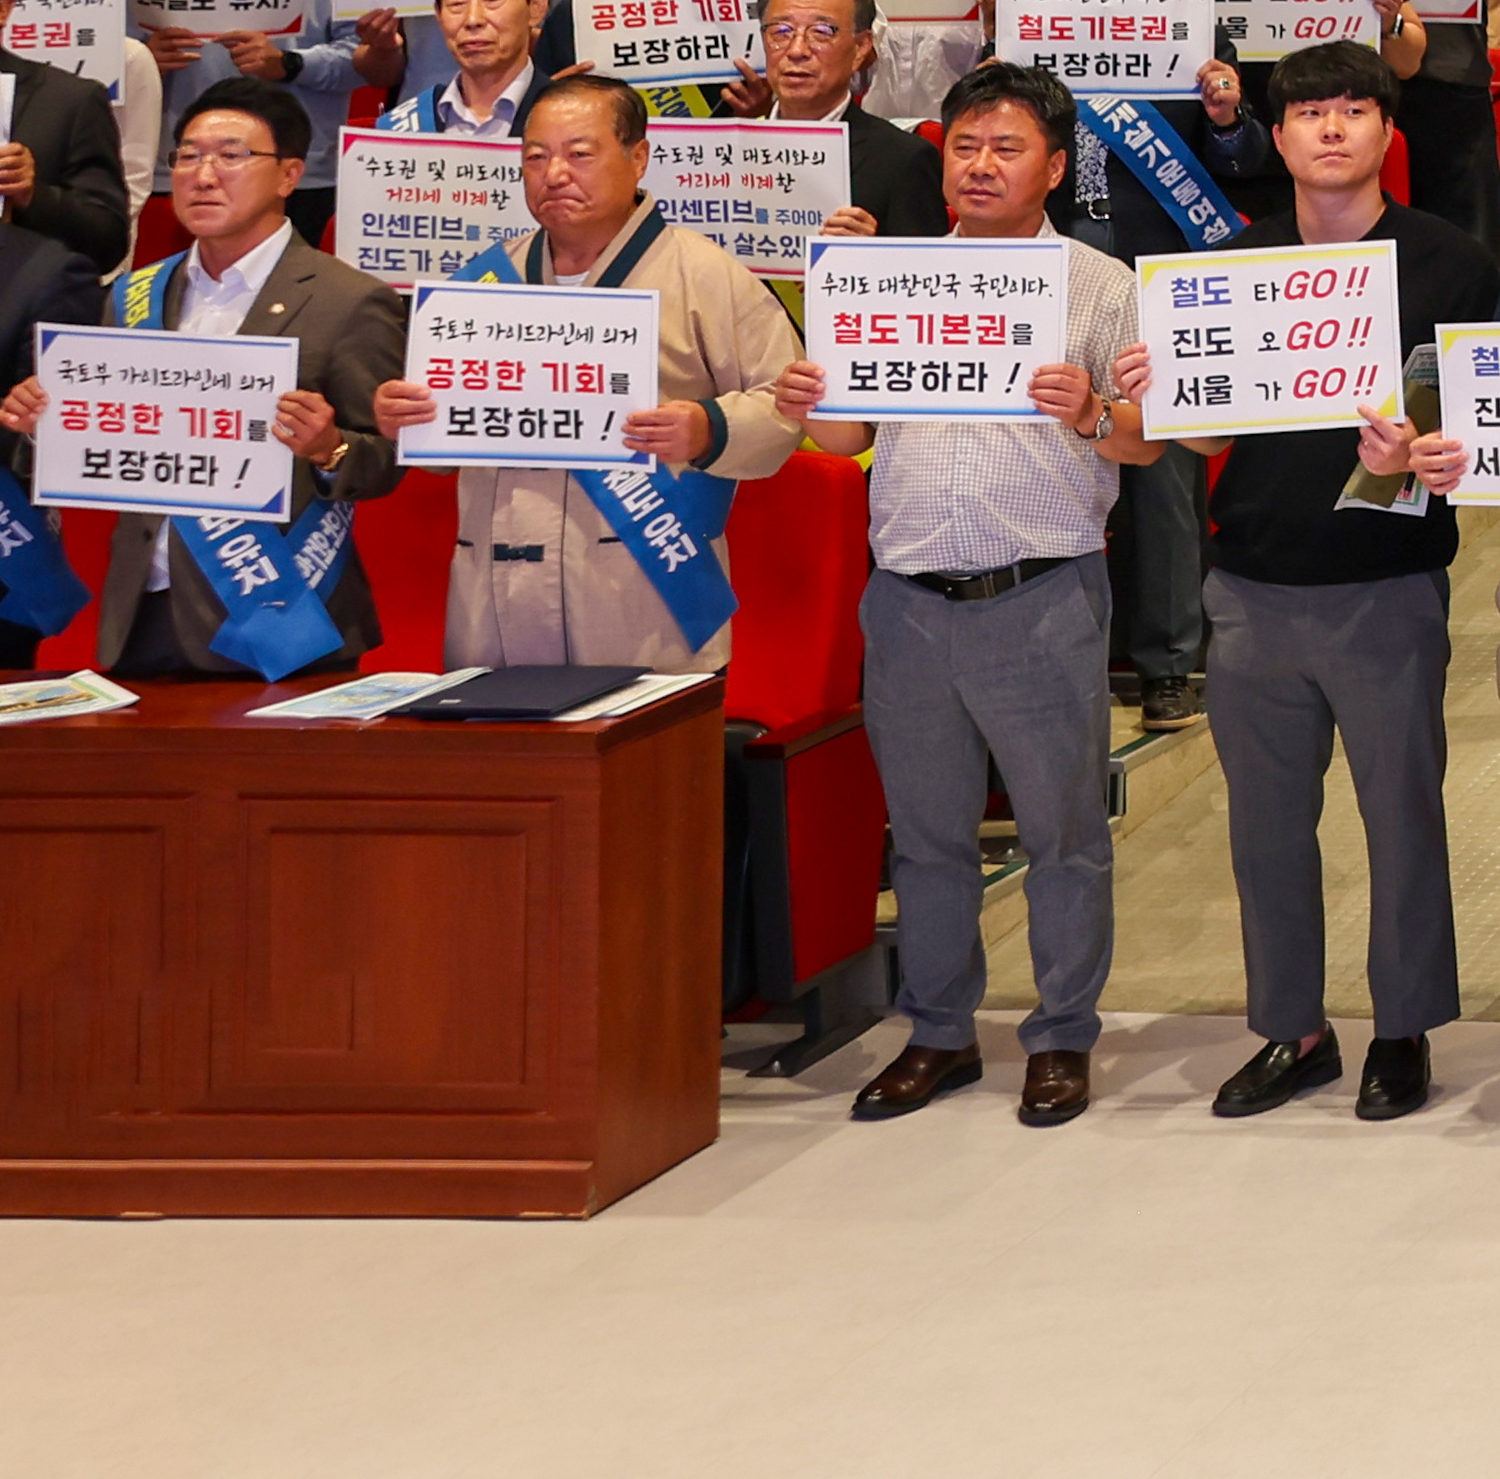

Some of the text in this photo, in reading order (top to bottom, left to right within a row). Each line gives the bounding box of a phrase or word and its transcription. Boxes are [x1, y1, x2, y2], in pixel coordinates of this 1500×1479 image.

[821, 272, 1052, 298] 우리도 대한민국 국민이다.
[1170, 275, 1232, 308] 철도
[833, 312, 1033, 345] 철도기본권을
[1172, 326, 1234, 358] 진도
[57, 359, 275, 392] 국토부 가이드라인에 의거
[1173, 374, 1233, 407] 서울
[60, 400, 268, 442] 공정한 기회를
[643, 512, 699, 573] 유치
